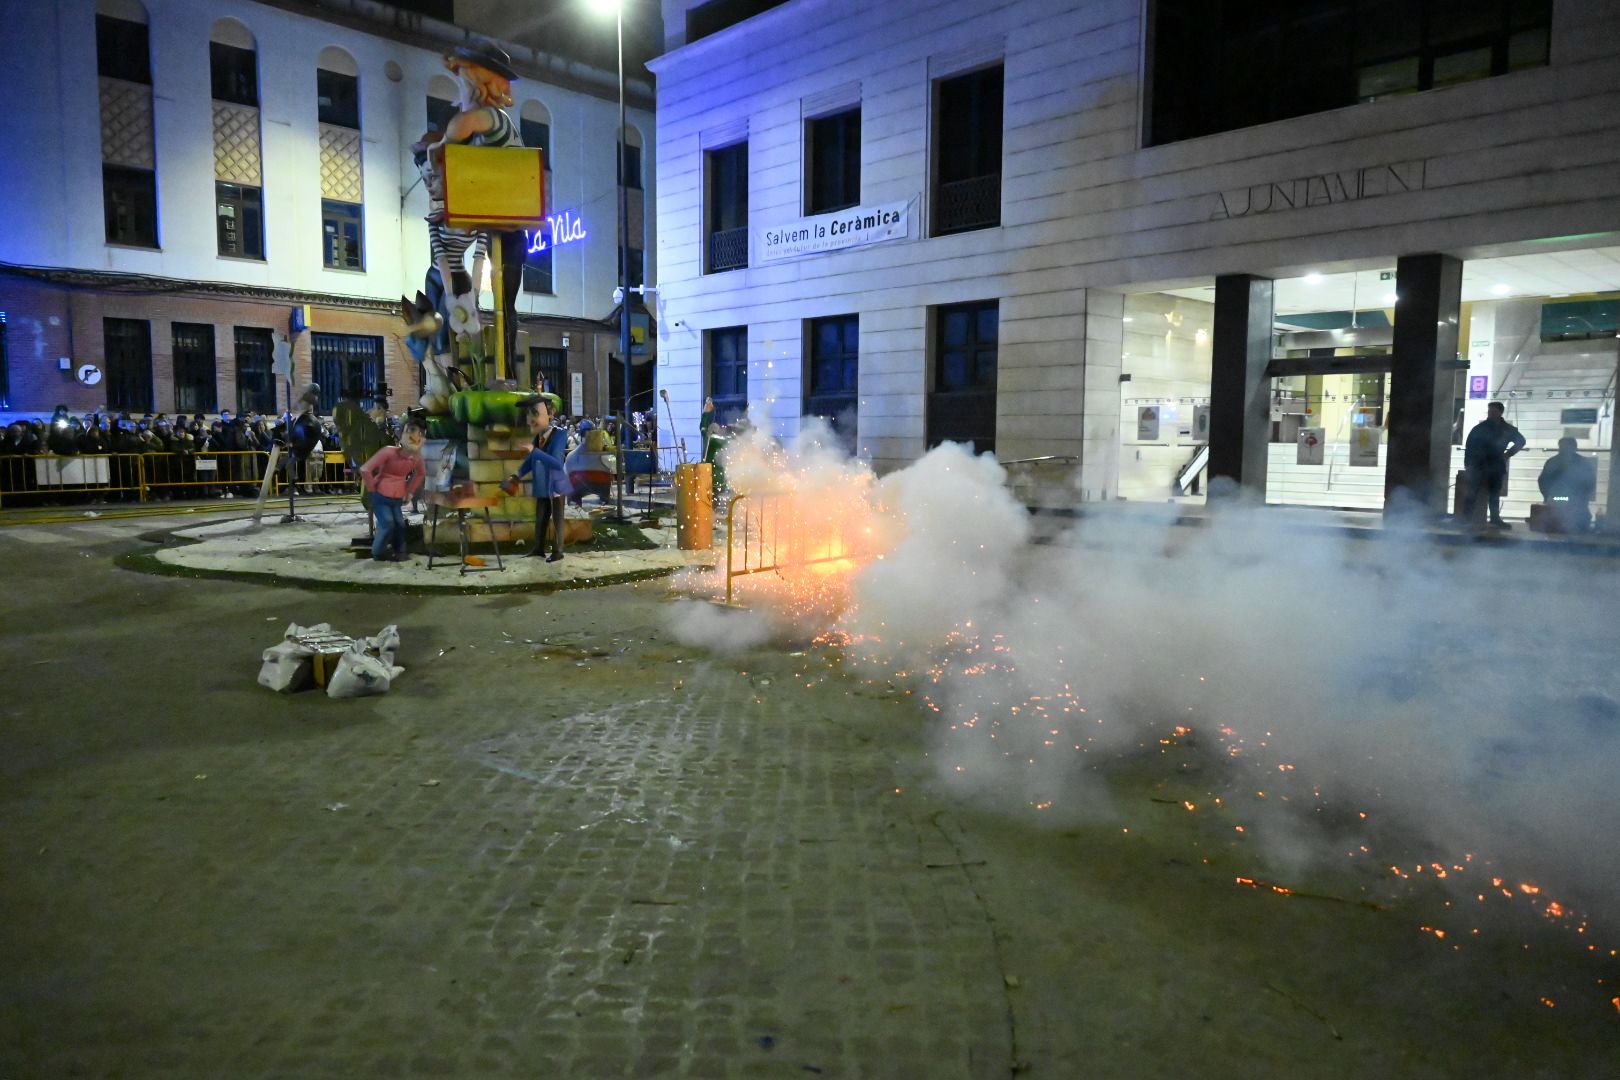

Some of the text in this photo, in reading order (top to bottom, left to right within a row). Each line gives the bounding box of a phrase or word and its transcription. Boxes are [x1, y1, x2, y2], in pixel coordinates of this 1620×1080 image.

[1209, 159, 1430, 221] AJUNTAMENT
[547, 211, 587, 245] Vila
[766, 209, 900, 246] Salvem la Ceràmica
